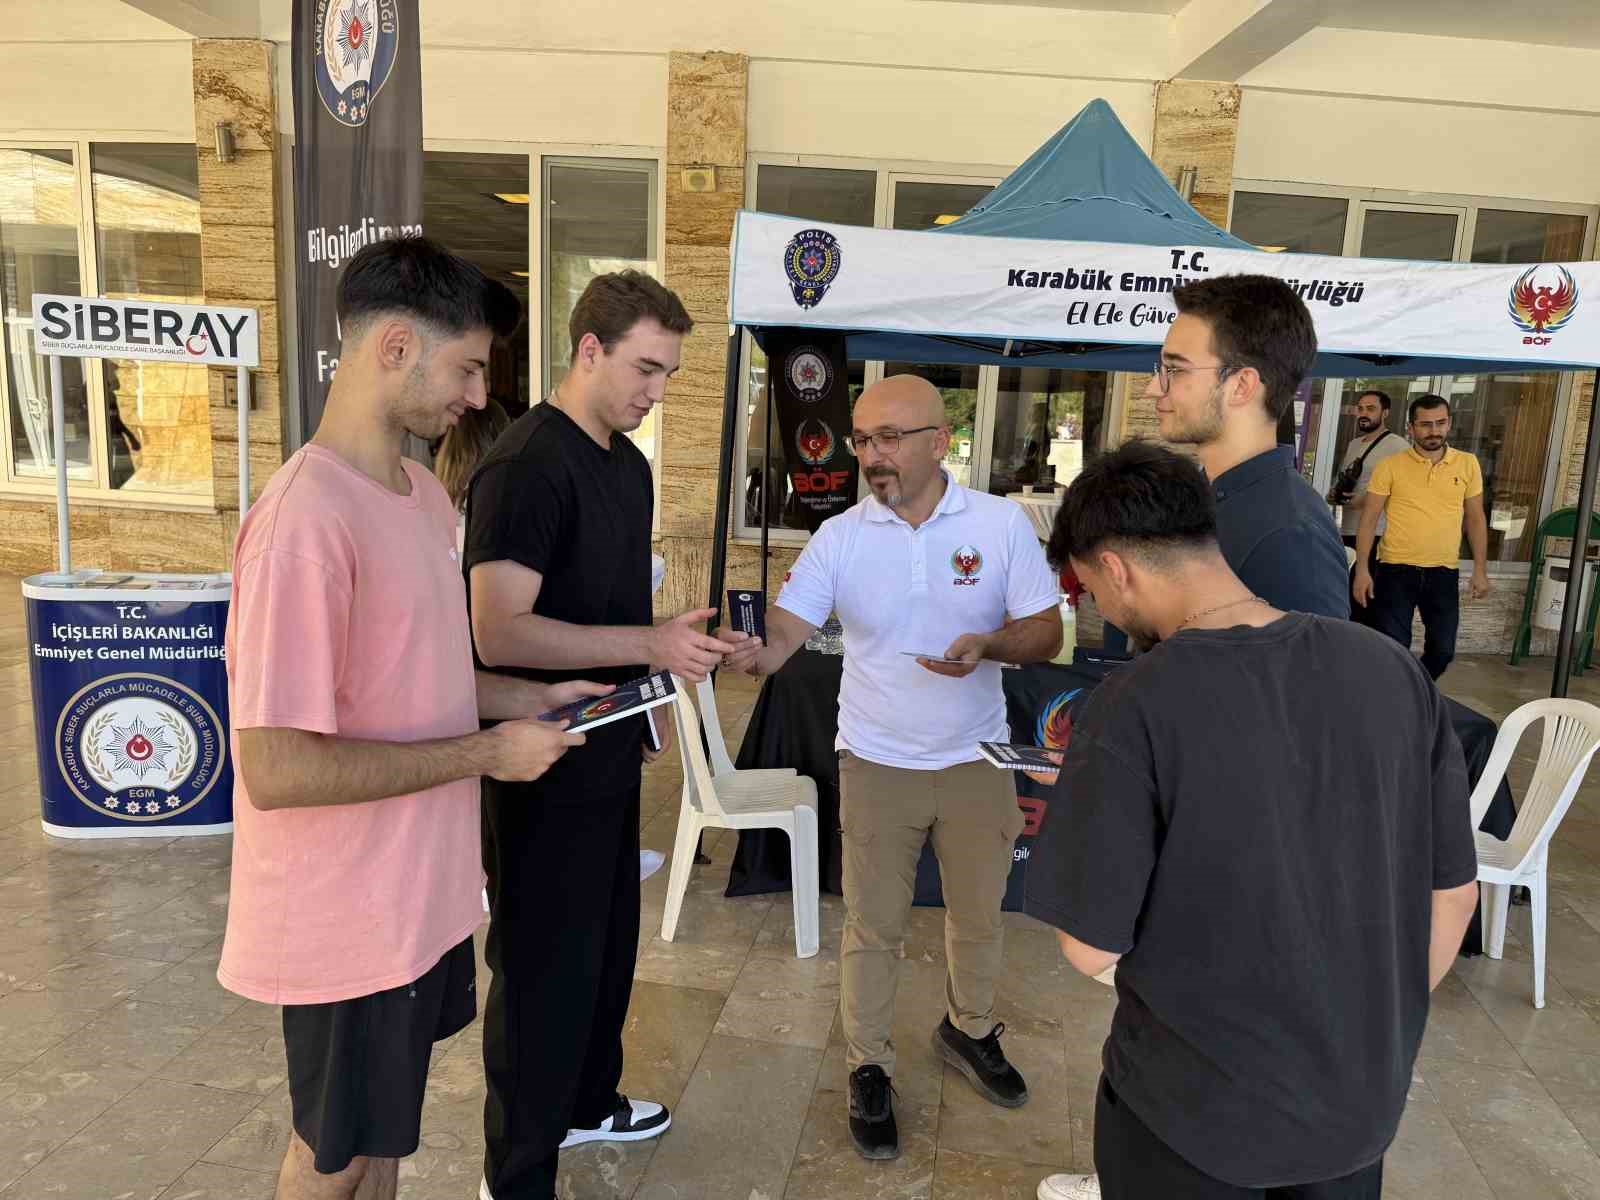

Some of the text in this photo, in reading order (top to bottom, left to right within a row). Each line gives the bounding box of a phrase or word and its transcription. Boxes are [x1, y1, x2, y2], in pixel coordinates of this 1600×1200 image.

[1171, 249, 1209, 272] T.C.
[1007, 268, 1113, 292] Karabük
[1066, 301, 1089, 326] El
[1093, 302, 1124, 327] Ele
[116, 605, 147, 619] T.C.
[51, 622, 213, 642] İÇİŞLERİ BAKANLIĞI
[34, 643, 94, 662] Emniyet
[97, 646, 145, 660] Genel
[128, 683, 187, 708] MÜCADELE
[128, 789, 156, 799] EGM
